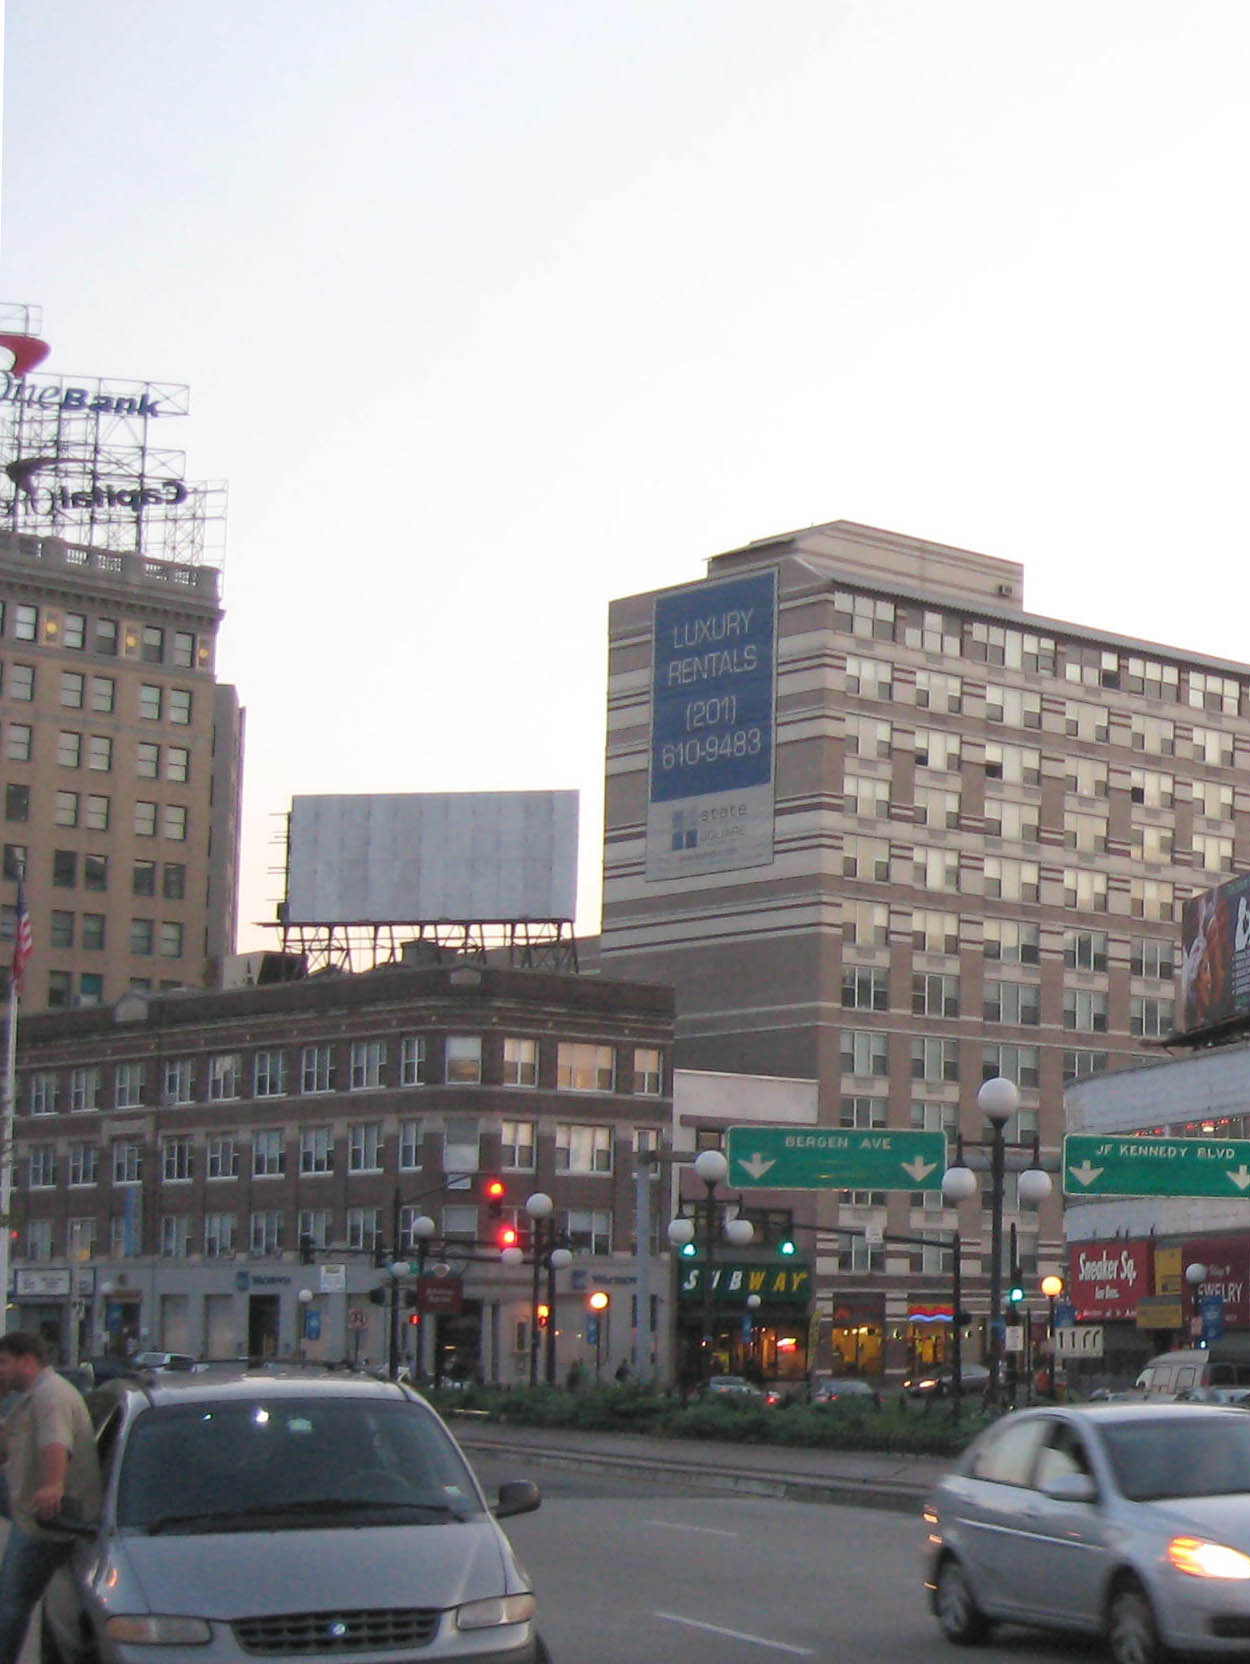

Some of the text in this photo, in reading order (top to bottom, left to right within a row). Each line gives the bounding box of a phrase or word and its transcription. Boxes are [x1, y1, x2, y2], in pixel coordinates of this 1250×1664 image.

[60, 388, 159, 417] Bank
[673, 608, 754, 649] LUXURY
[667, 645, 758, 687] RENTALS
[686, 695, 737, 732] (201)
[662, 728, 761, 770] 610-9483
[785, 1136, 892, 1150] BERGEN AVE
[1097, 1144, 1236, 1159] JF KENNEDY BLVD
[1079, 1249, 1119, 1281] Sneaker
[1191, 1281, 1244, 1304] EWELRY
